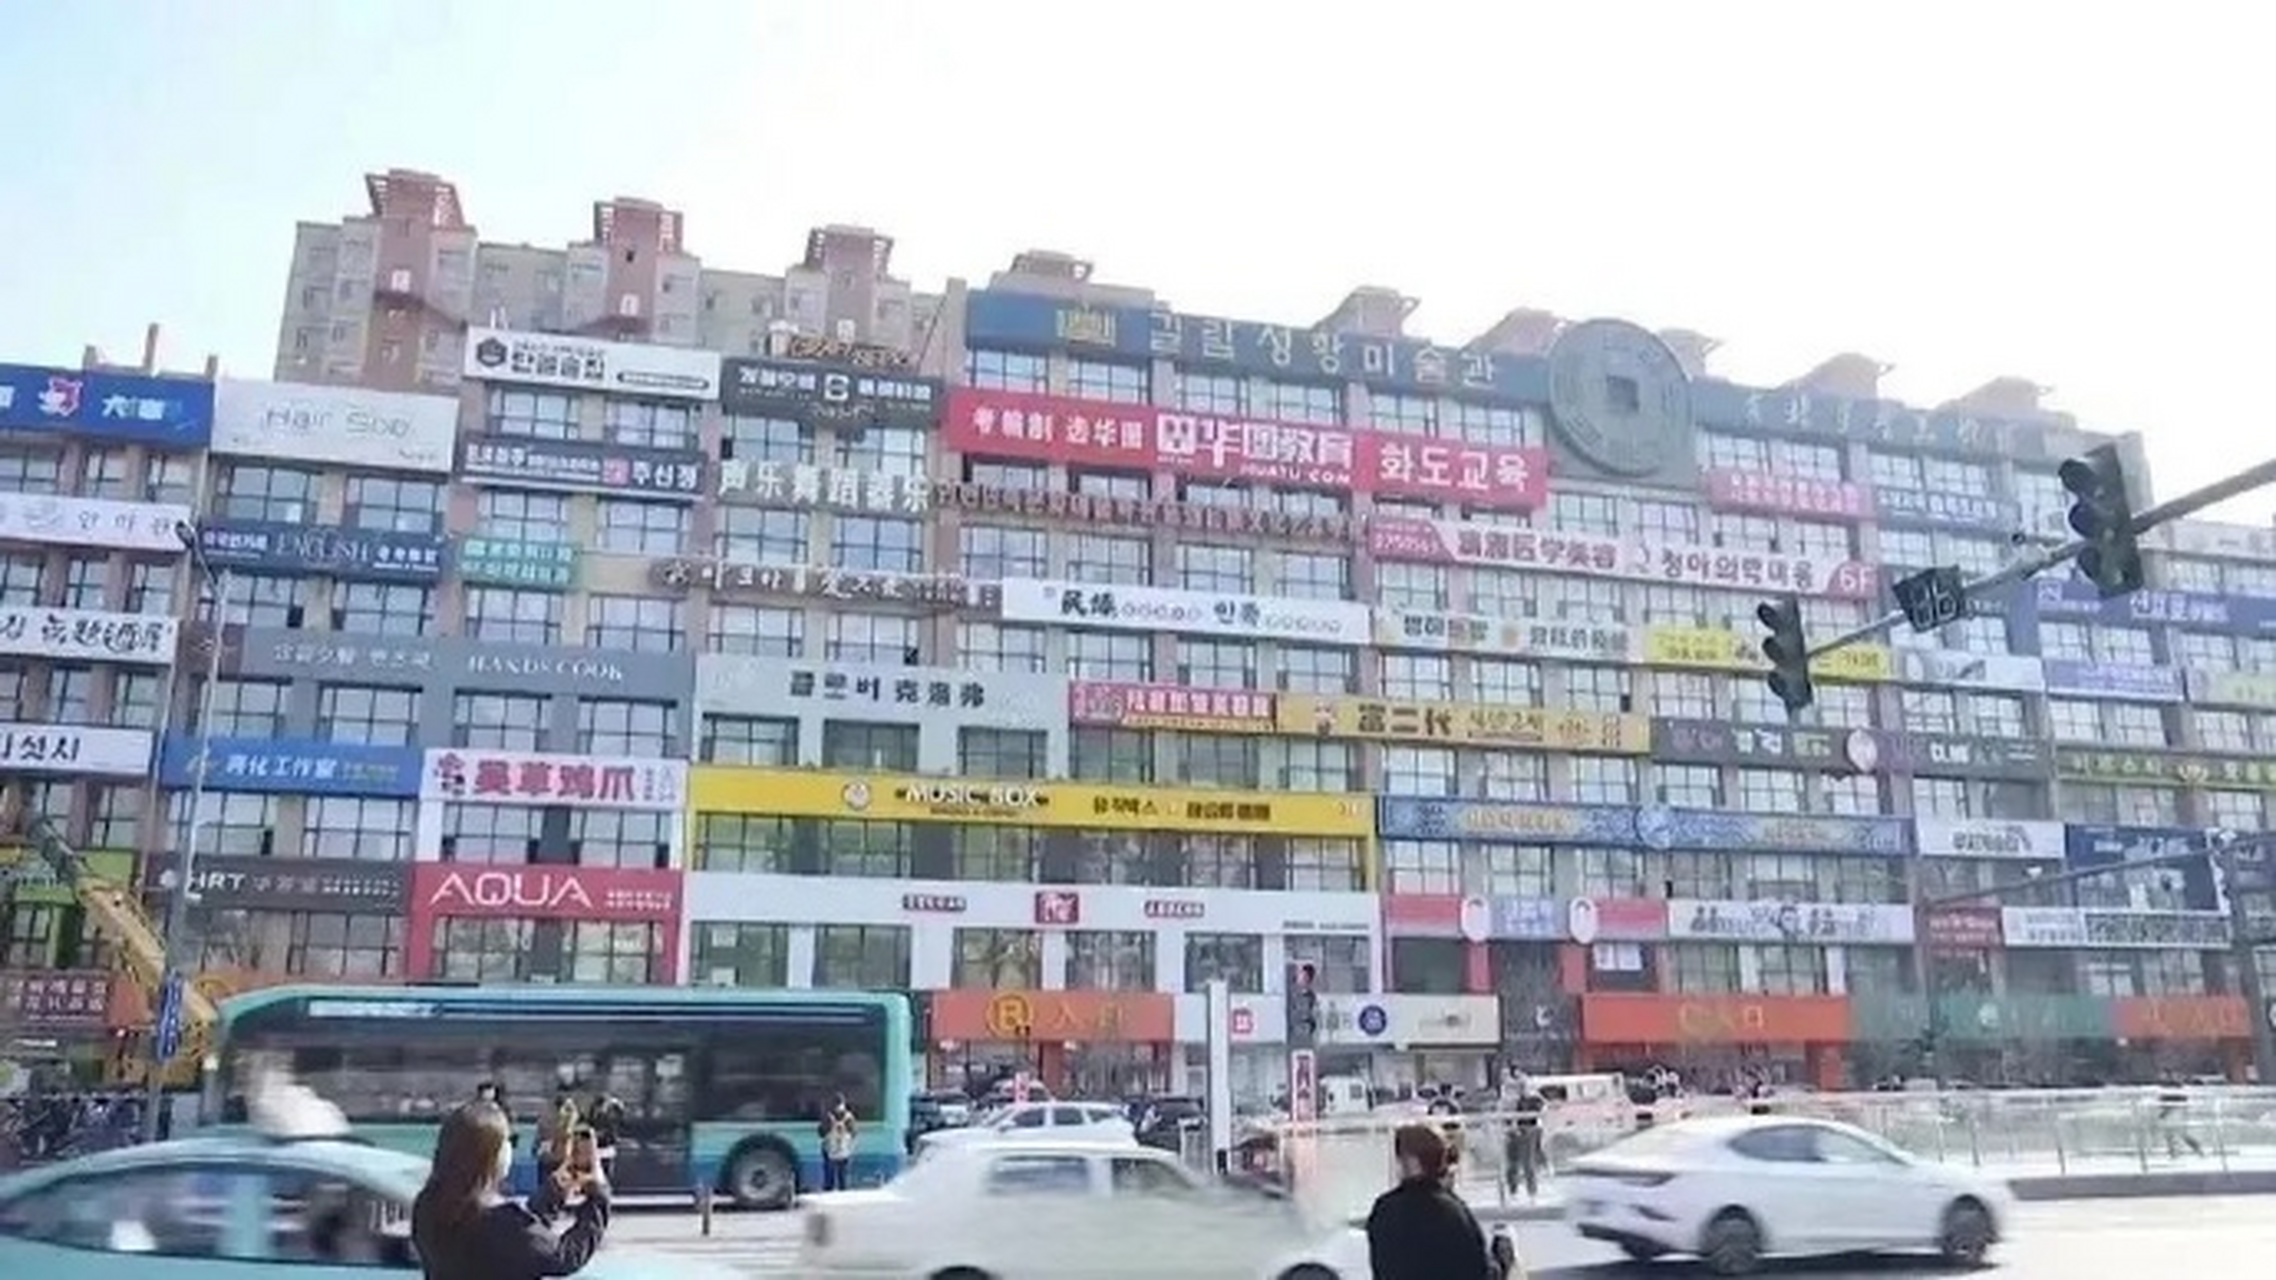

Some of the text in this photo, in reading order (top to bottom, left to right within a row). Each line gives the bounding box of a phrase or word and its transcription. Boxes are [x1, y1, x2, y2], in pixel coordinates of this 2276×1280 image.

[1380, 444, 1530, 493] 화도교육
[905, 782, 1040, 807] MUSIC BOX
[429, 871, 594, 908] AQUA
